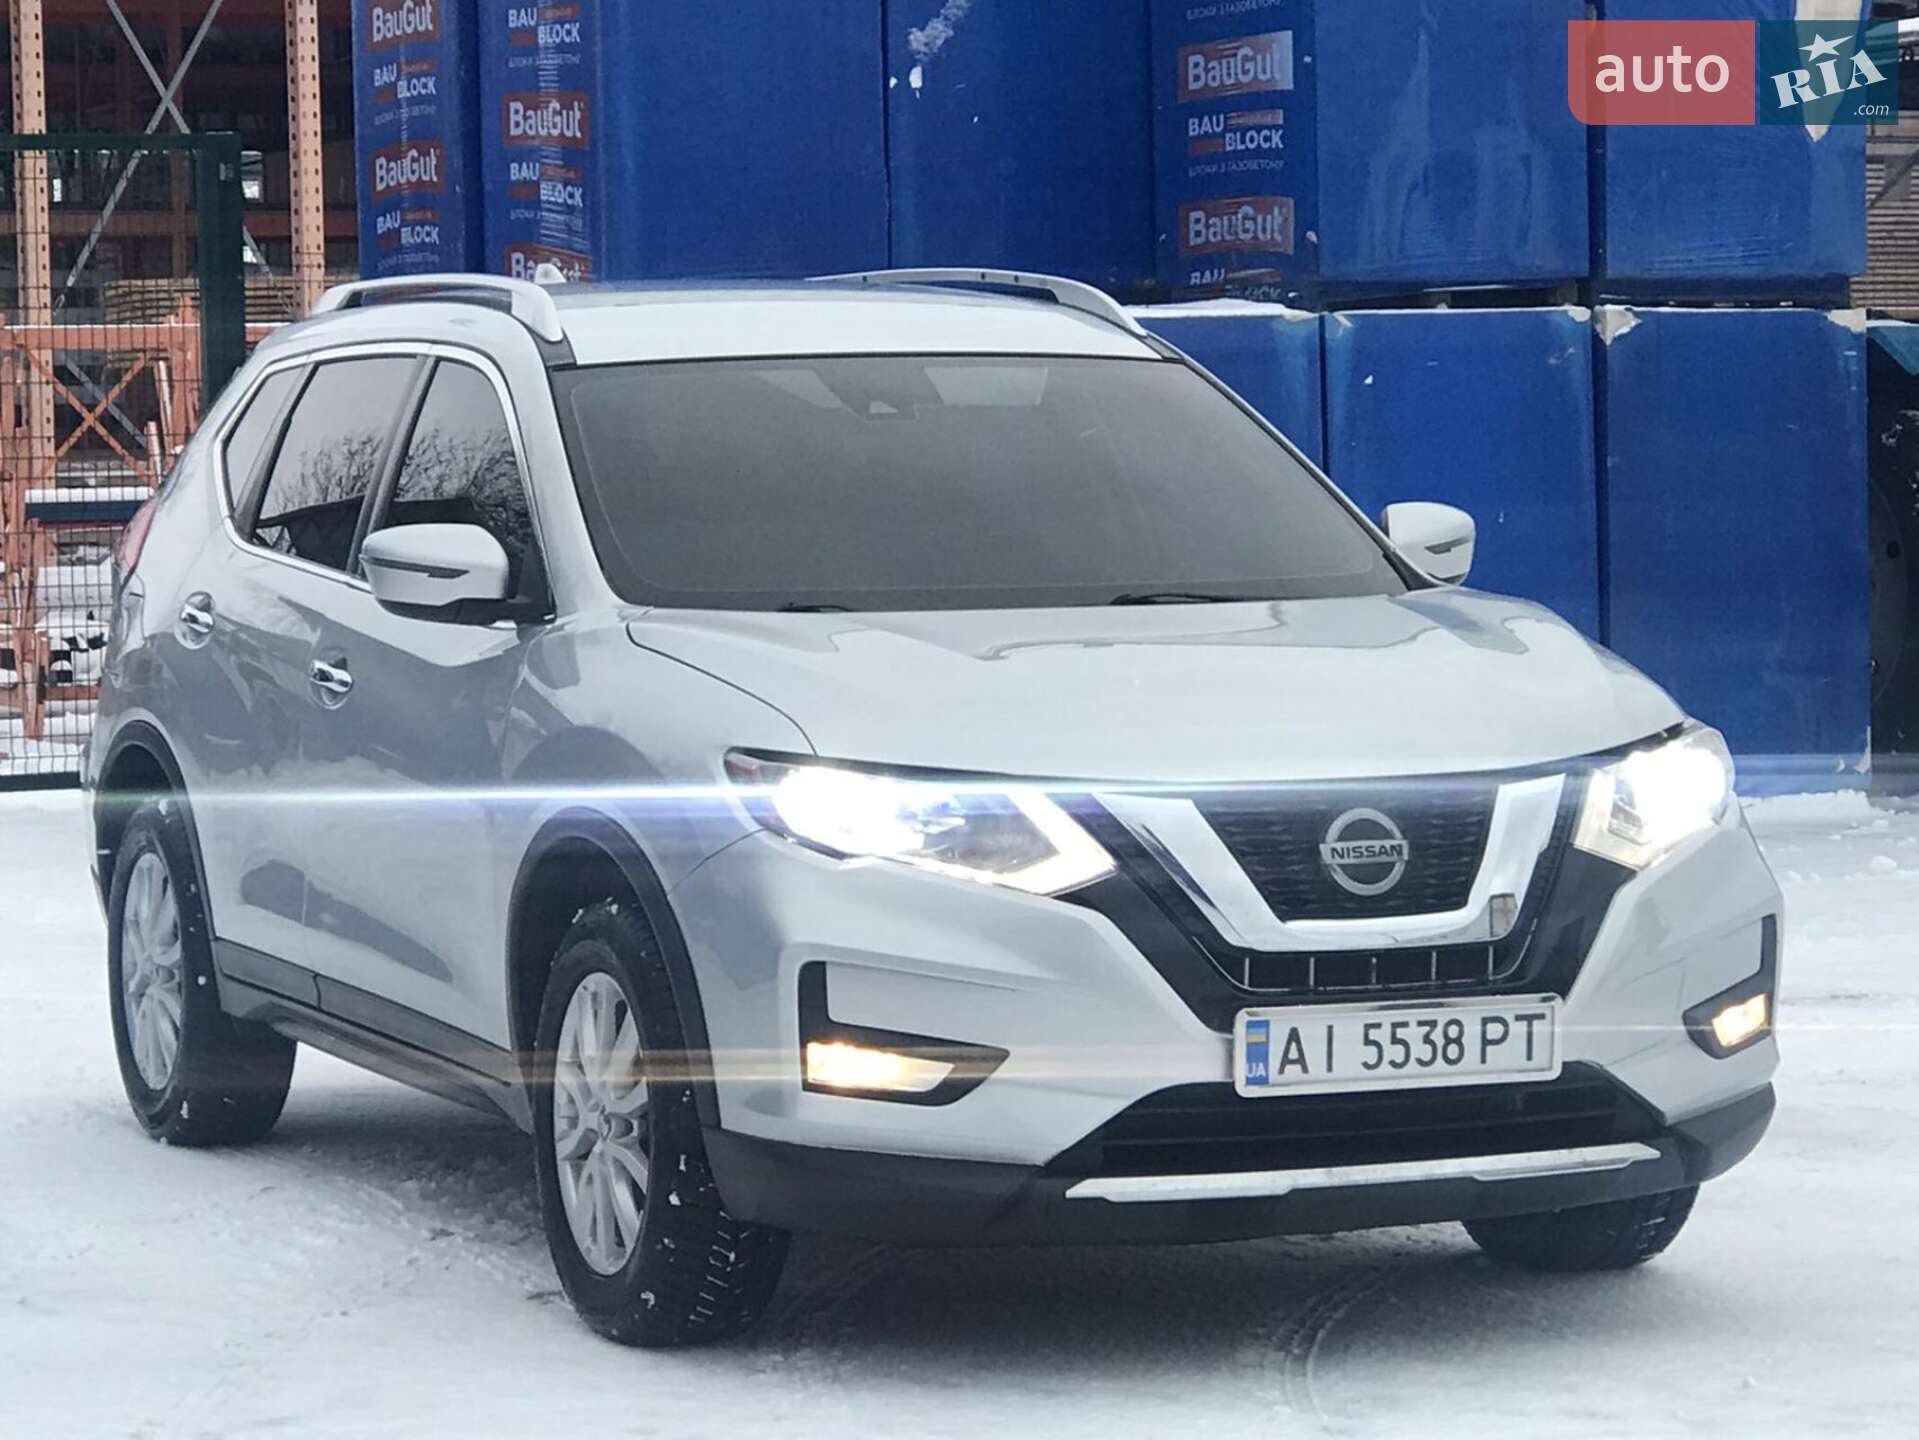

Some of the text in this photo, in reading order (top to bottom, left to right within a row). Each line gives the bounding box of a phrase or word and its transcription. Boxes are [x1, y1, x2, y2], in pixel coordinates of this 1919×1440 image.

[372, 0, 434, 43] BauGut
[508, 7, 538, 28] BAU
[538, 22, 581, 44] BLOCK
[374, 63, 397, 87] BAU
[1187, 45, 1283, 91] BauGut
[397, 76, 437, 99] BLOCK
[509, 100, 582, 138] BauGut
[1188, 114, 1225, 137] BAU
[1225, 129, 1284, 151] BLOCK
[375, 149, 438, 191] BauGut
[510, 162, 539, 181] BAU
[540, 181, 583, 208] BLOCK
[376, 210, 401, 234] BAU
[1188, 206, 1283, 246] BauGut
[401, 225, 440, 246] BLOCK
[1330, 843, 1404, 860] NISSAN
[1277, 1012, 1547, 1076] AI 5538 PT
[1246, 1062, 1267, 1078] UA
